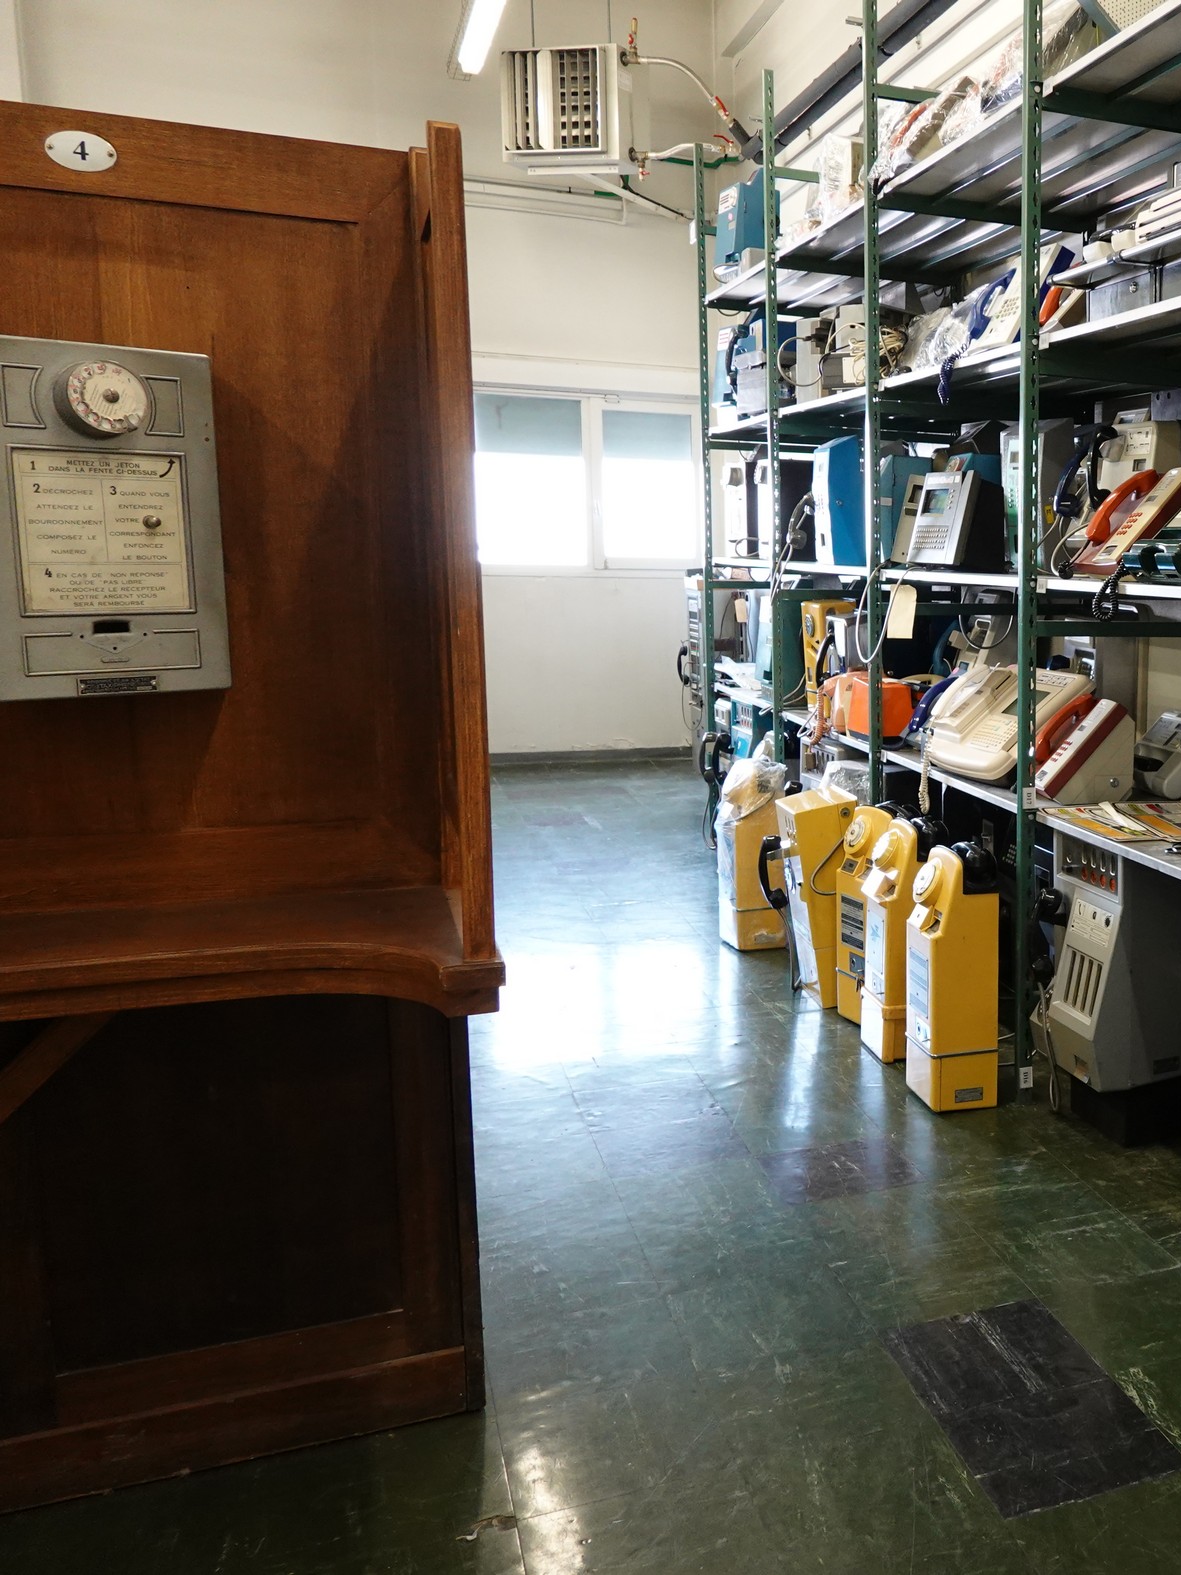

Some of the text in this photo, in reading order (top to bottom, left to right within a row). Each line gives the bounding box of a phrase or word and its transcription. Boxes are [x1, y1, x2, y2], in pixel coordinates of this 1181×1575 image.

[73, 141, 90, 161] 4
[30, 461, 36, 470] 1
[33, 483, 41, 493] 2
[110, 485, 117, 495] 3
[45, 568, 52, 578] 4
